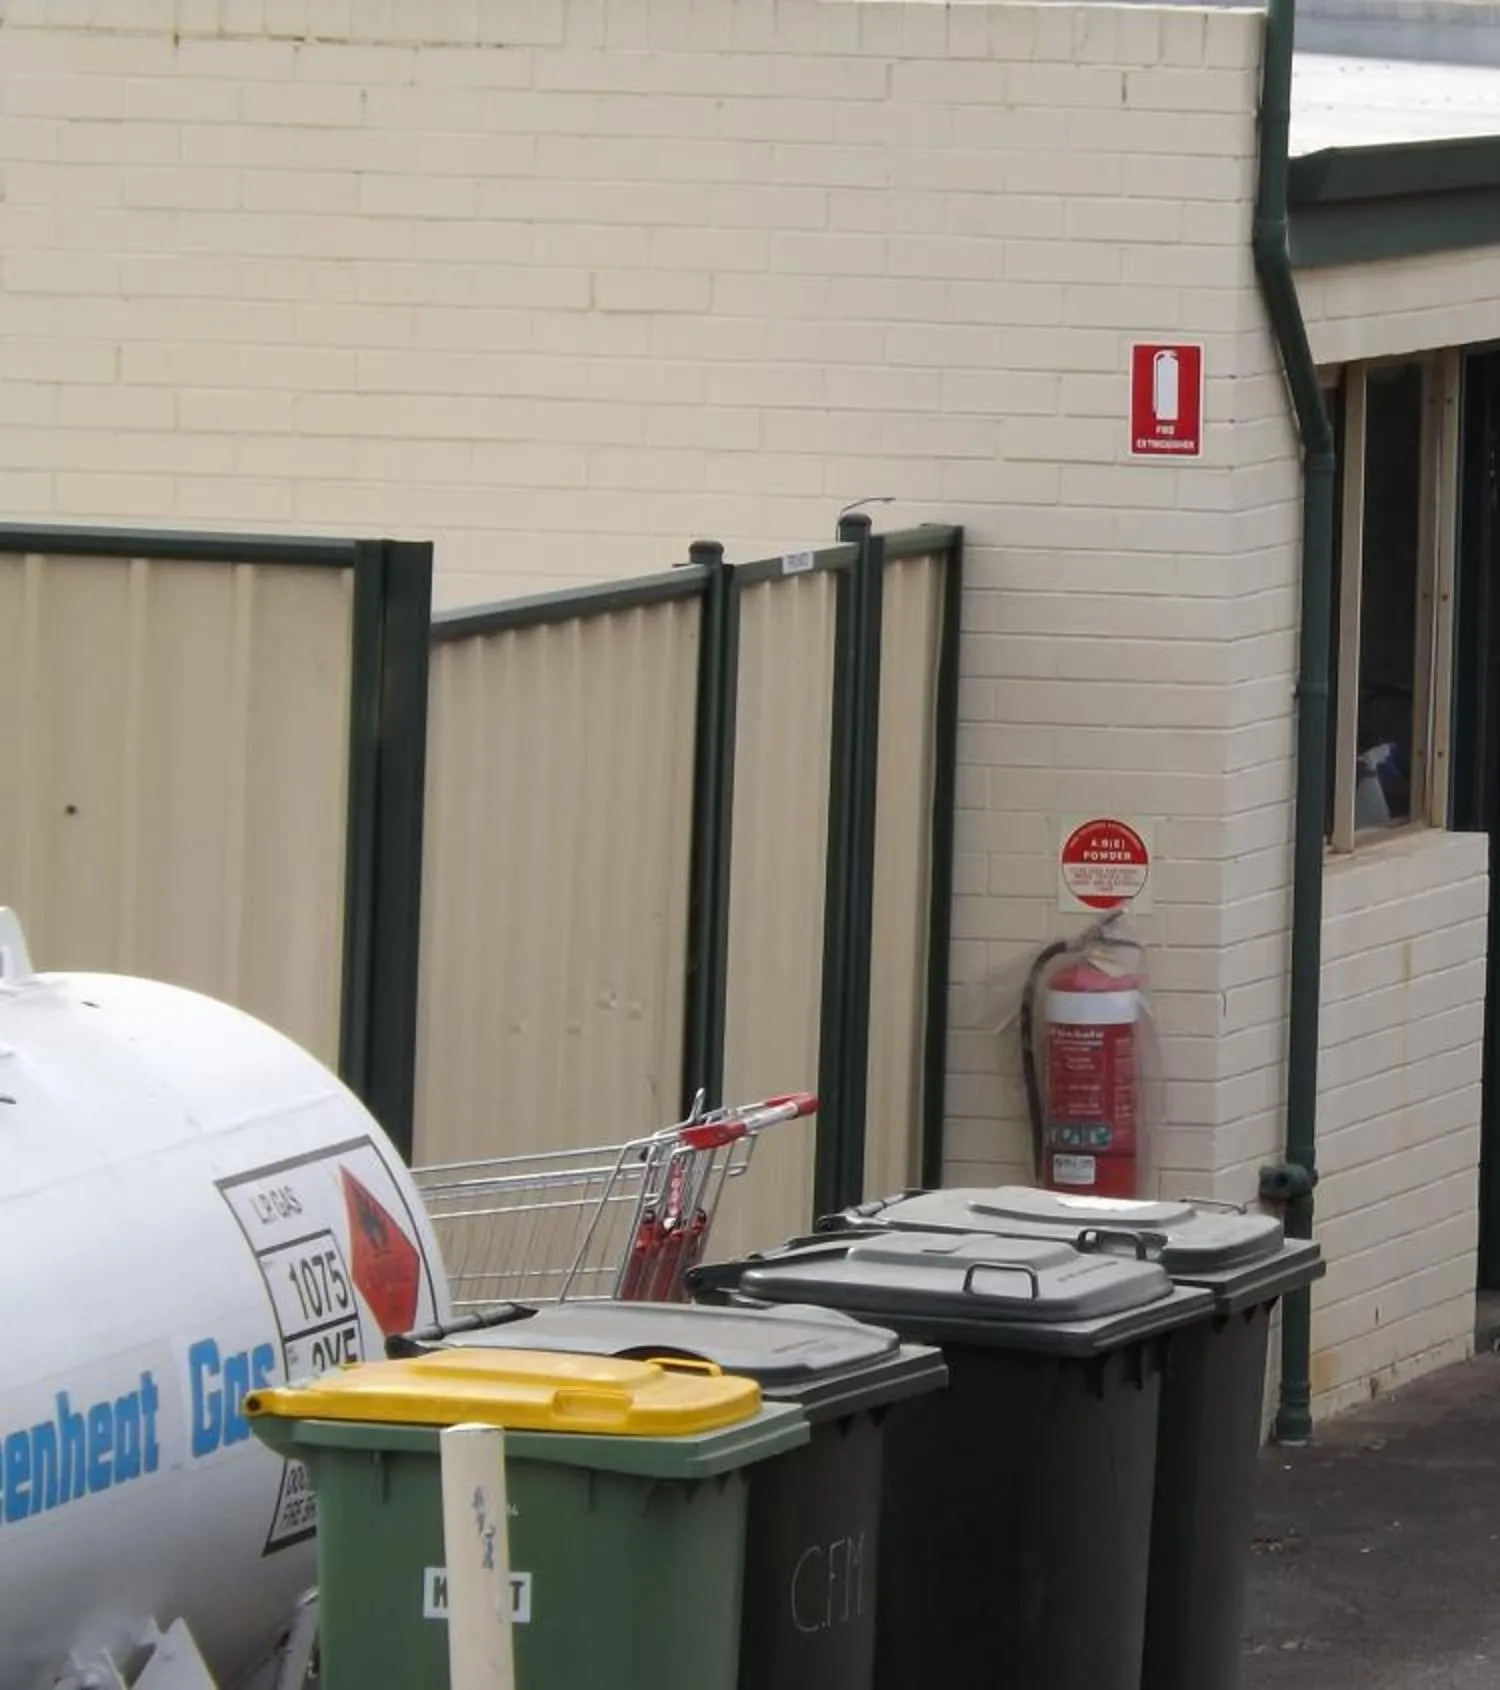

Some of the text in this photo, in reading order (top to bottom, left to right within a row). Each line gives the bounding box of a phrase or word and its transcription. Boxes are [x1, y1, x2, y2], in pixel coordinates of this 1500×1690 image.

[1083, 851, 1131, 860] POWDER
[289, 1251, 348, 1320] 1075
[0, 1337, 275, 1525] enheat Gas
